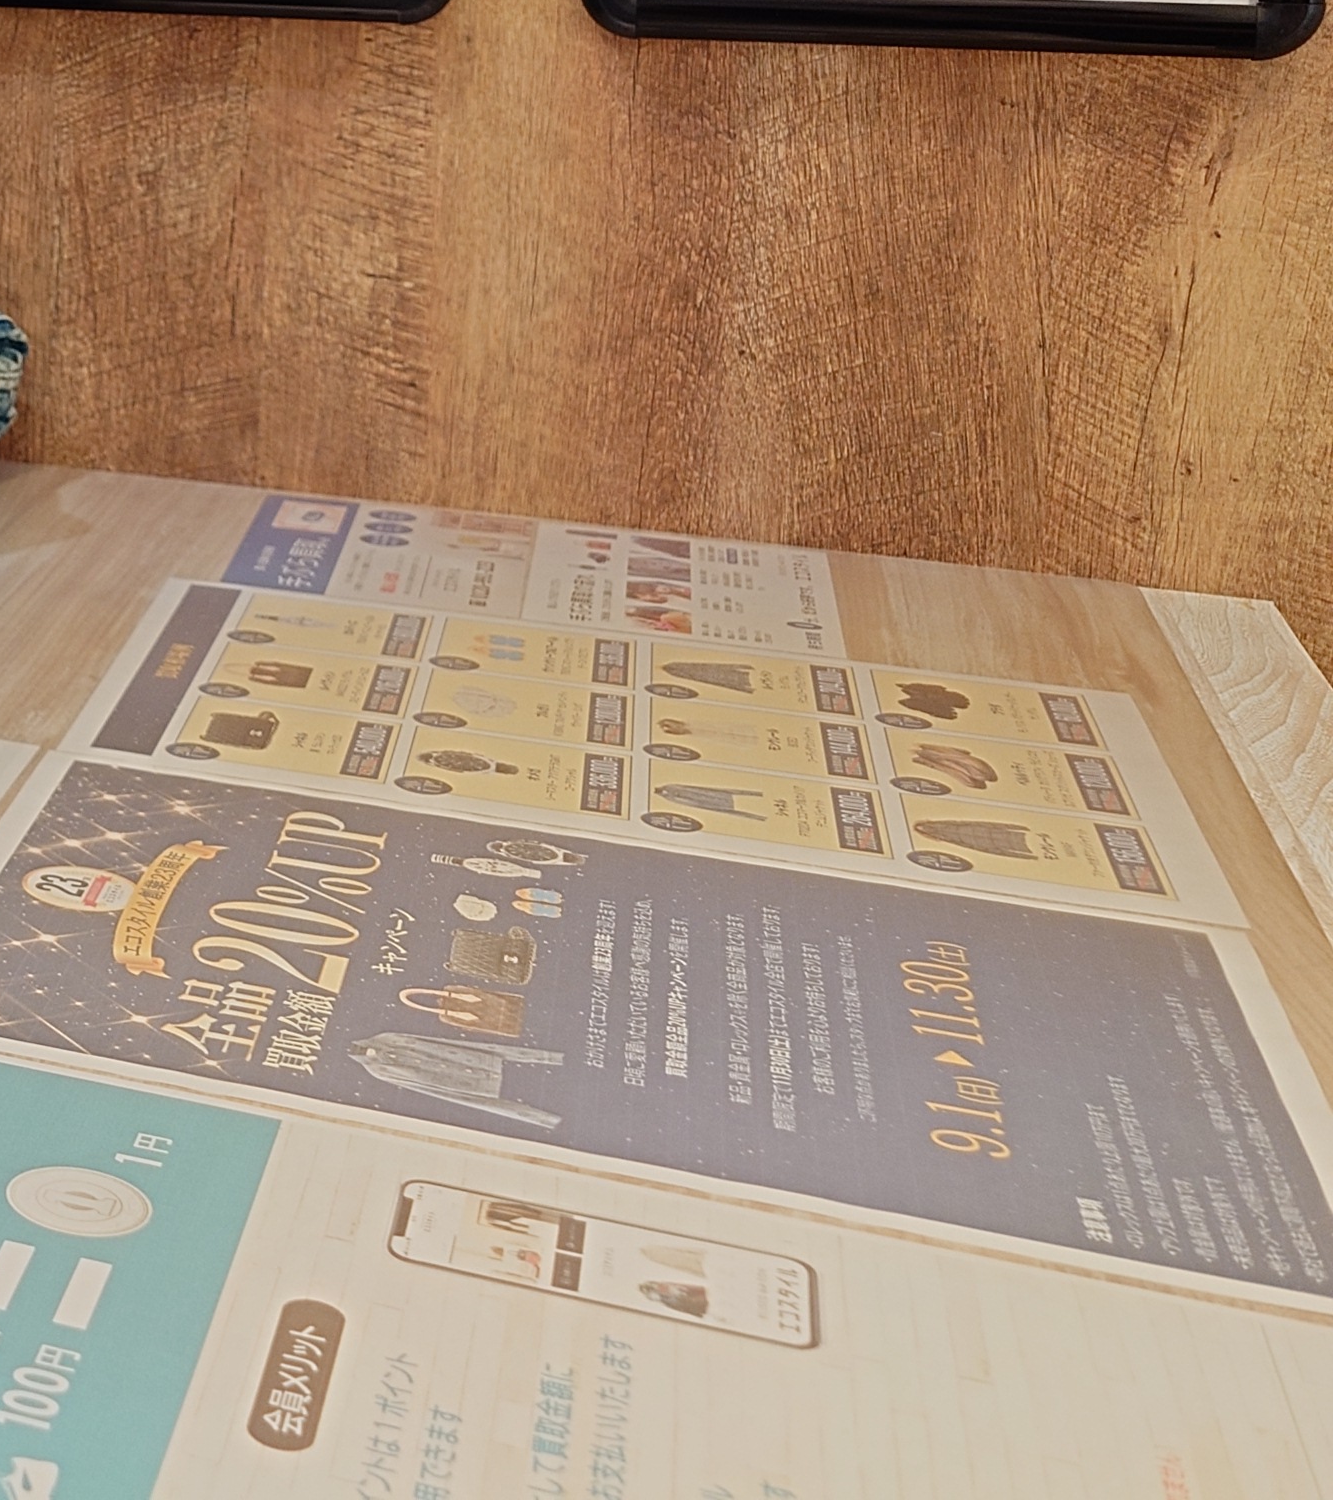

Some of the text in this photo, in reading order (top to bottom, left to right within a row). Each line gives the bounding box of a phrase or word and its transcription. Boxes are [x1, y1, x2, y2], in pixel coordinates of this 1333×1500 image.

[160, 810, 388, 1063] 全品 20%UP
[370, 909, 416, 976] キャンペーン
[261, 990, 337, 1076] 買取金額
[114, 1132, 174, 1169] 1円
[260, 1325, 328, 1437] 会員メリット
